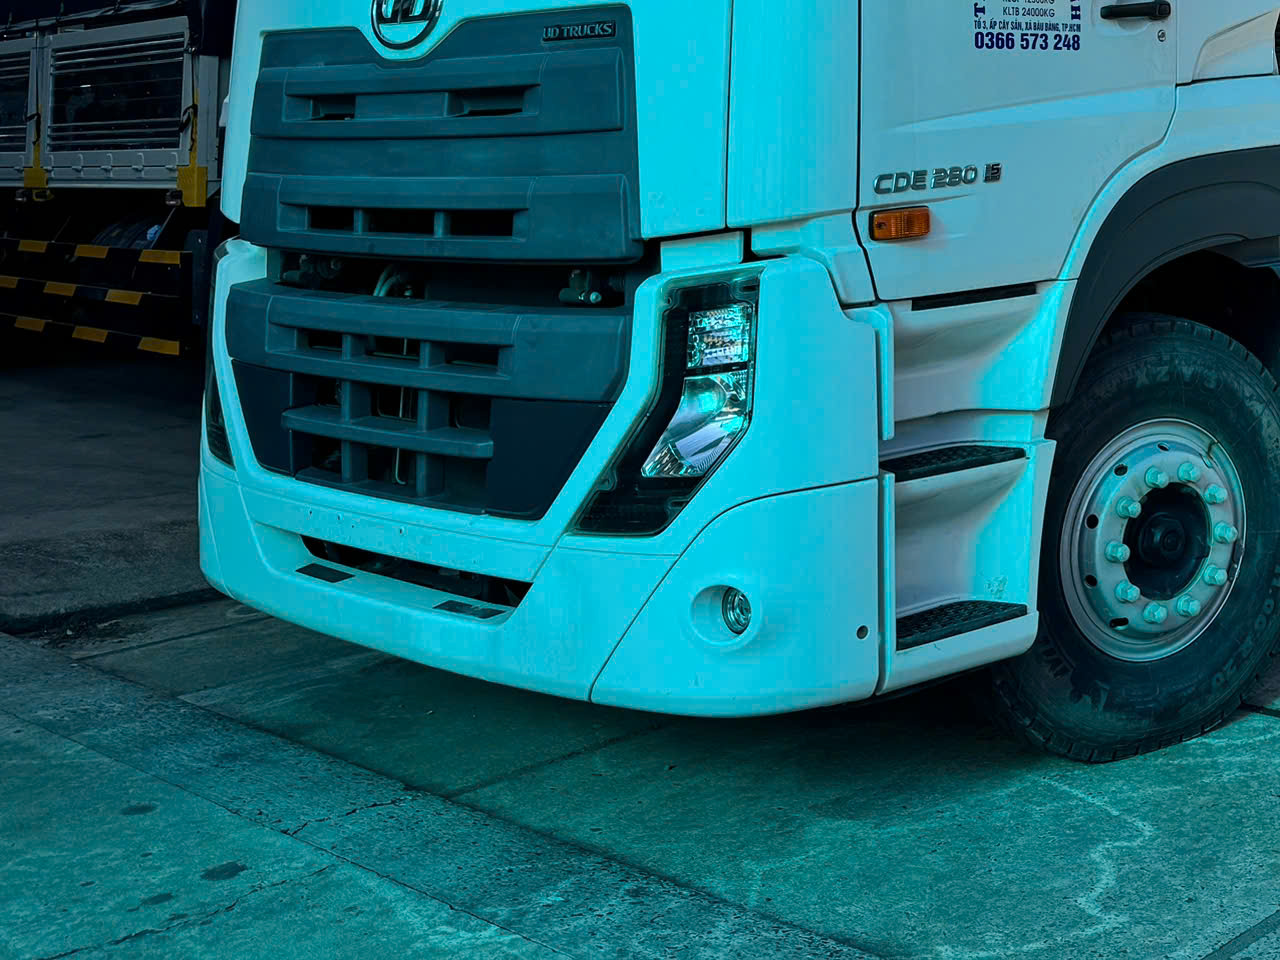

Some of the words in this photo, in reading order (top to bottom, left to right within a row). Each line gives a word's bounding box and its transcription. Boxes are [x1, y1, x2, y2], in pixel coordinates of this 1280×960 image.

[1002, 6, 1020, 16] KLTB
[1021, 7, 1056, 18] 24000KG
[542, 26, 560, 40] UD
[562, 22, 613, 39] TRUCKS
[974, 31, 1015, 50] 0366
[1020, 33, 1049, 51] 573
[1053, 33, 1081, 51] 248
[873, 169, 928, 195] CDE
[931, 164, 979, 190] 280
